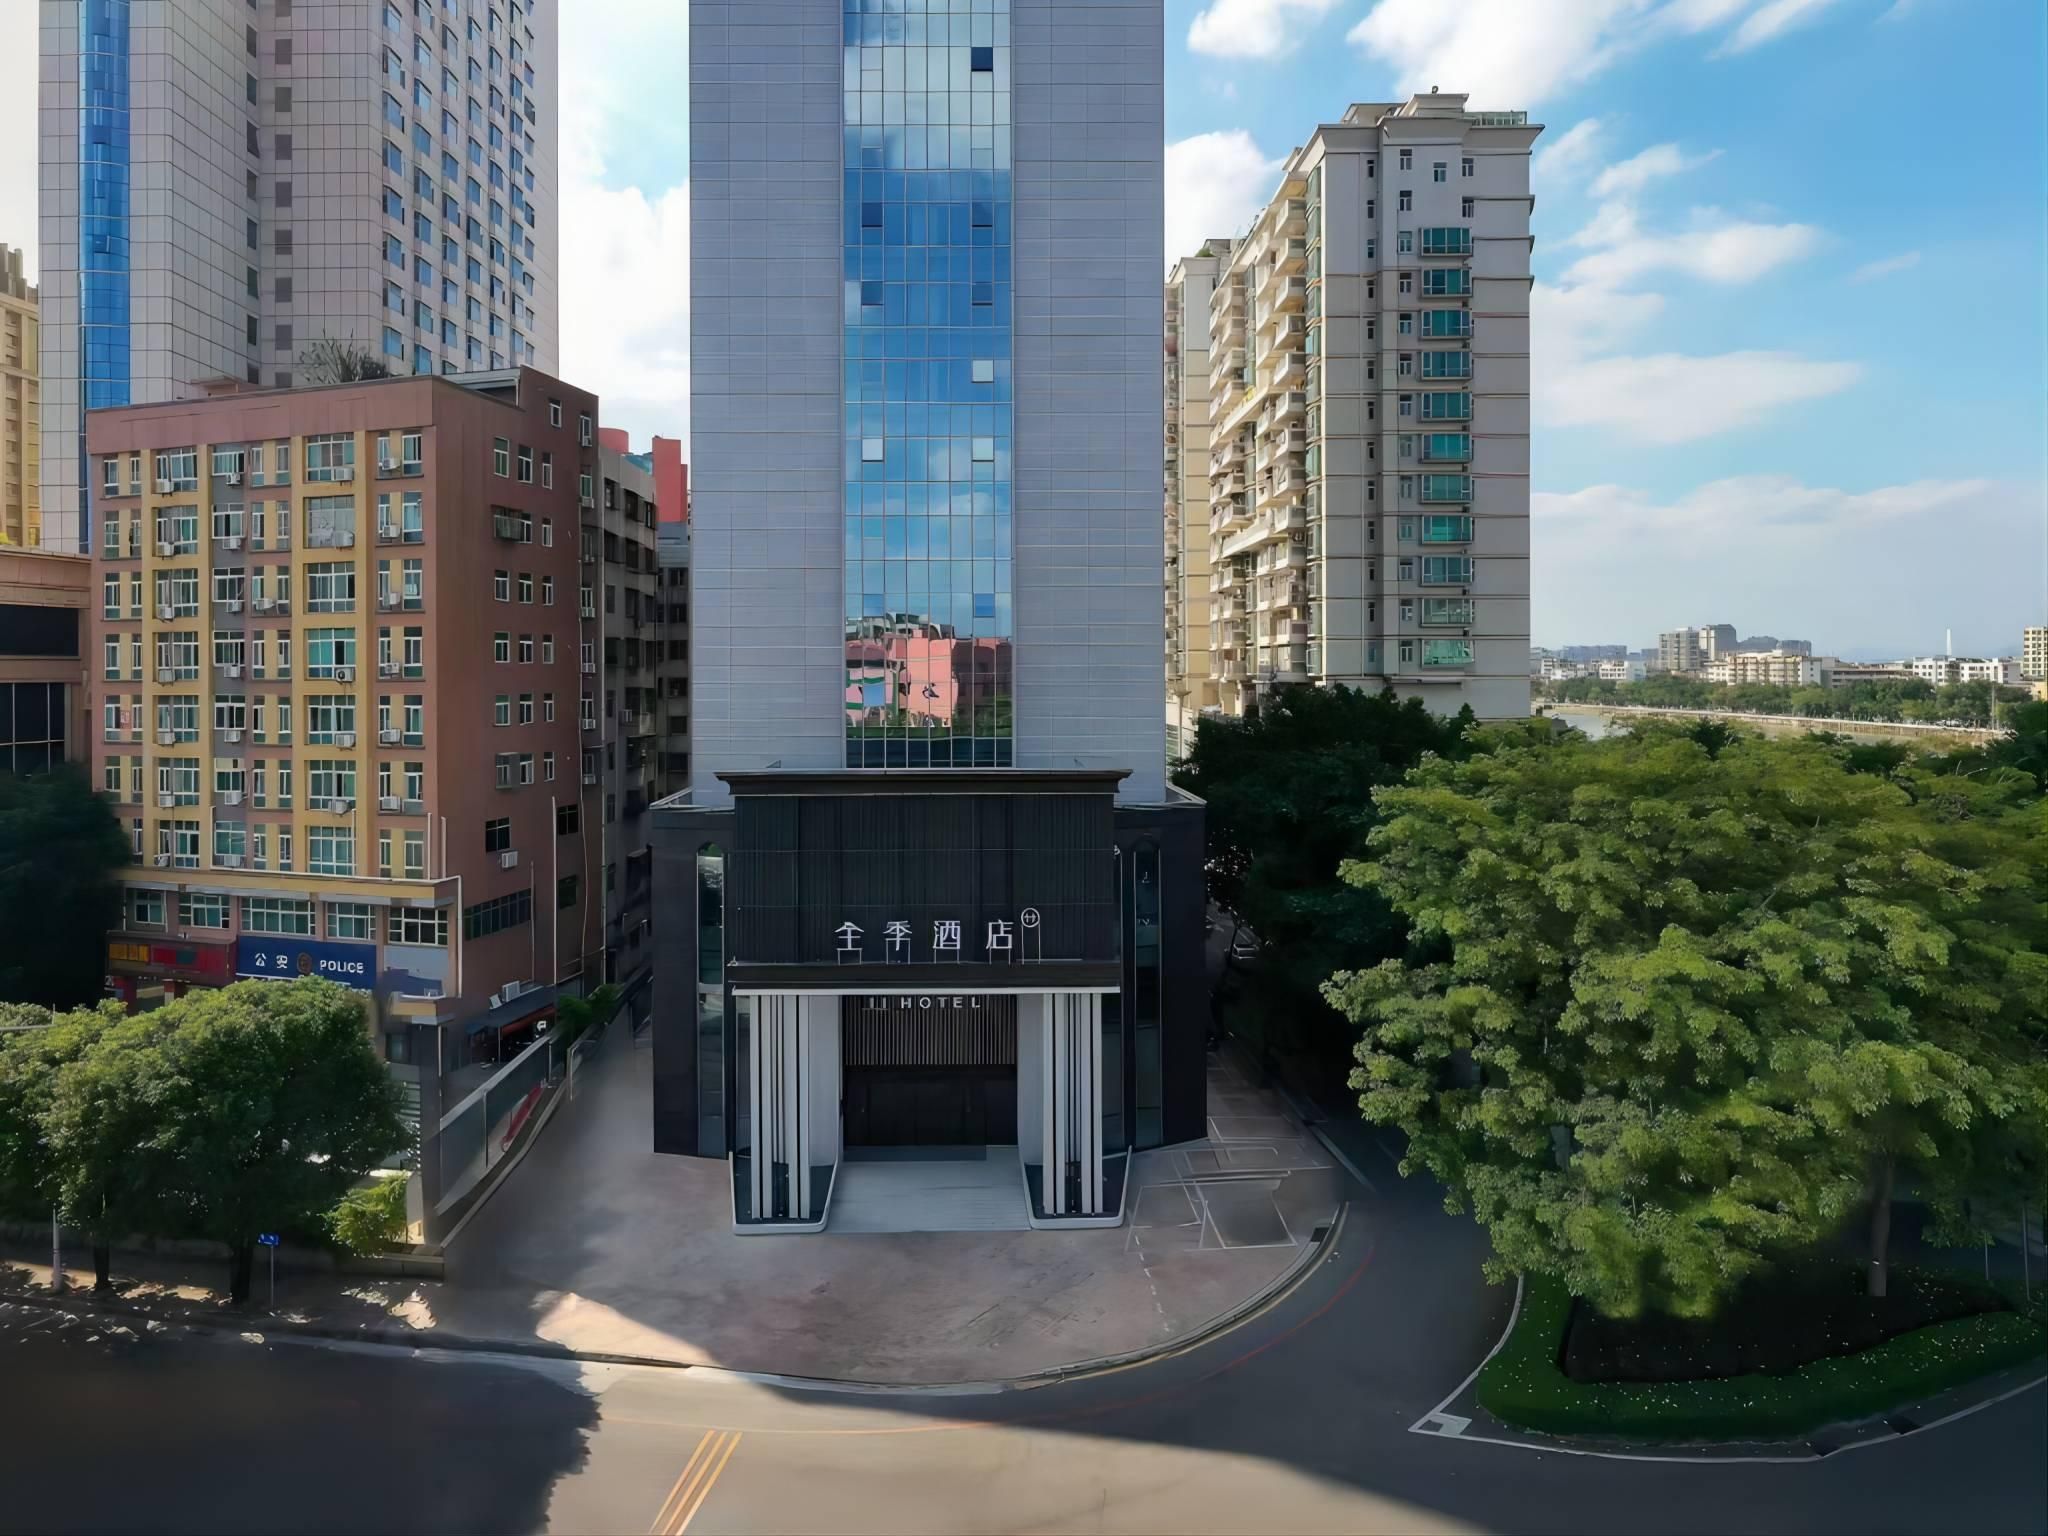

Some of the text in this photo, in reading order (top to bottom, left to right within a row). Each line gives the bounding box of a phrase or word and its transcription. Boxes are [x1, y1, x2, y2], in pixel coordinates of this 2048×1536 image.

[834, 919, 1014, 951] 全季酒店
[319, 959, 365, 974] POLICE
[900, 996, 981, 1009] HOTEL
